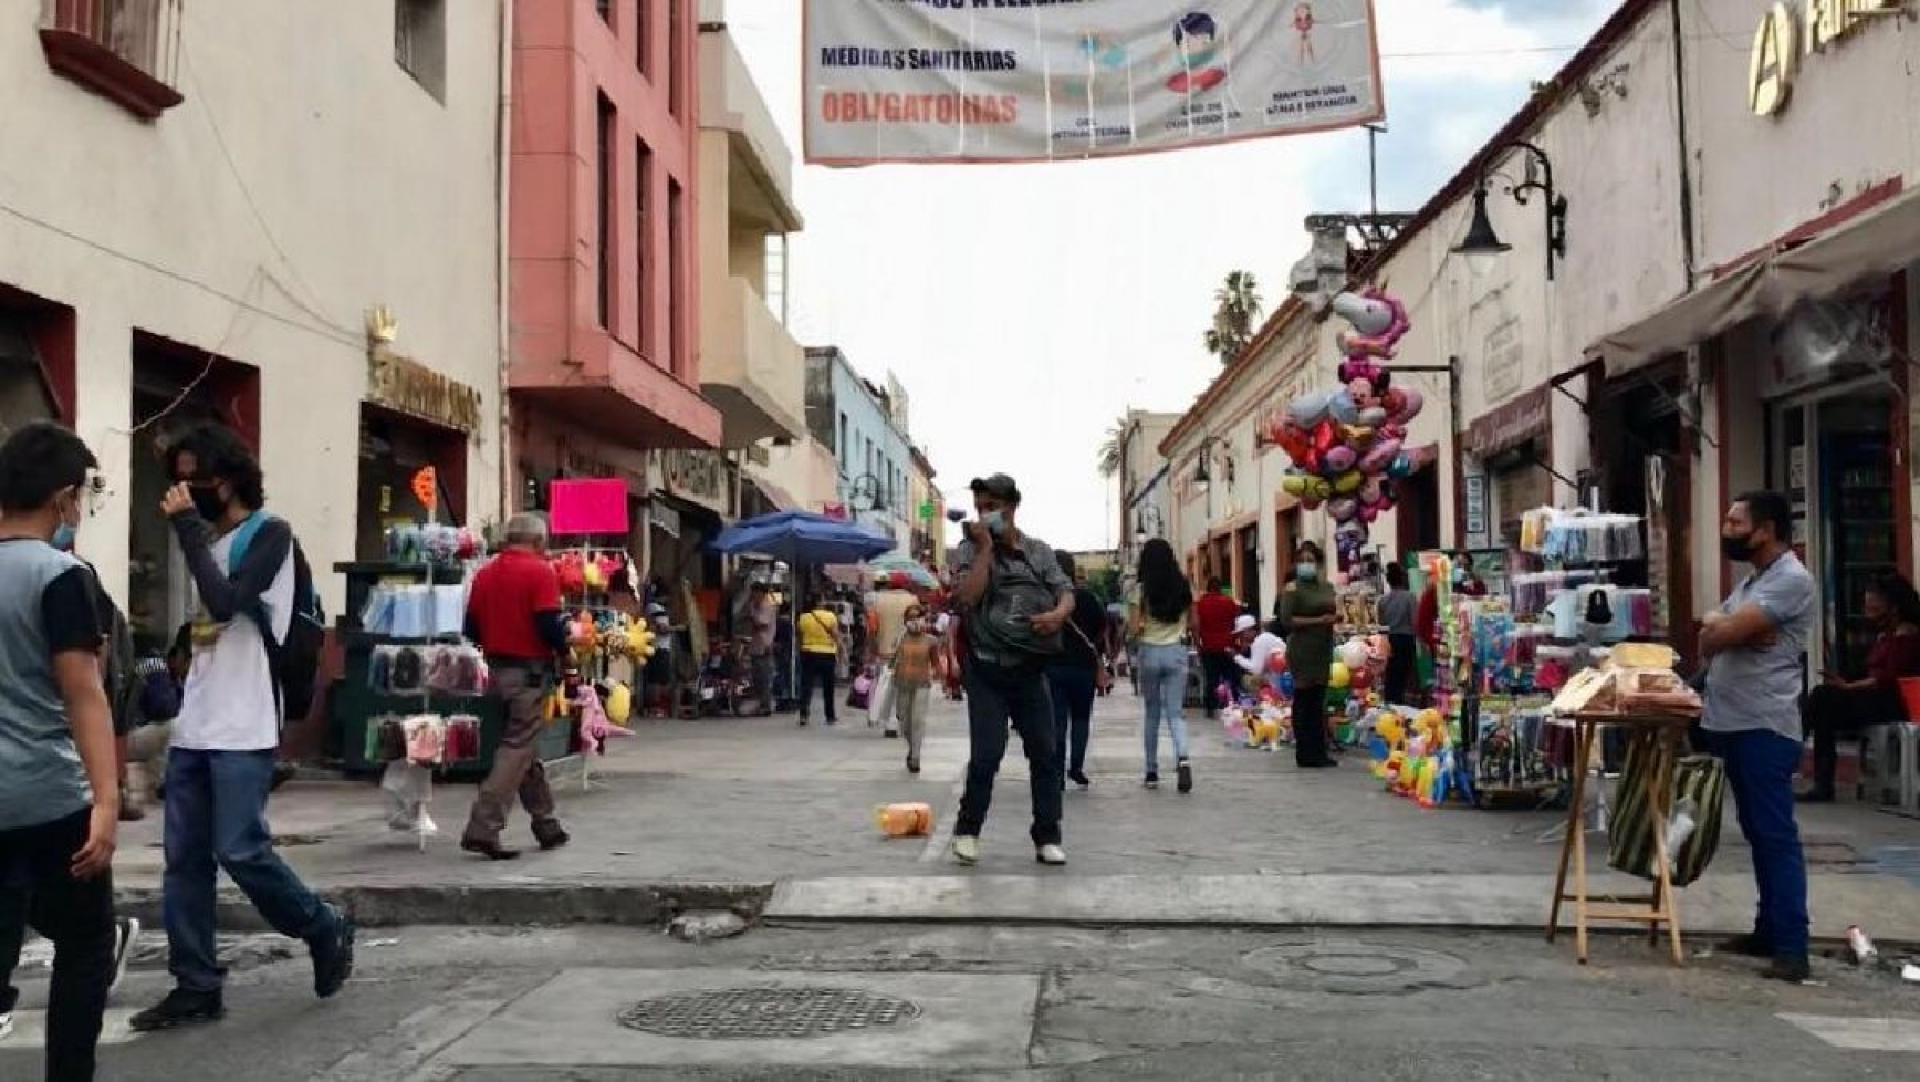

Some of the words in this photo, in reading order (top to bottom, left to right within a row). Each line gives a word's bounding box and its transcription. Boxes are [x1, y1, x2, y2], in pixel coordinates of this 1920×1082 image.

[821, 47, 904, 70] MEDIDAS
[908, 48, 1017, 71] SANITARIAS
[822, 91, 1017, 124] OBLIGATORIAS
